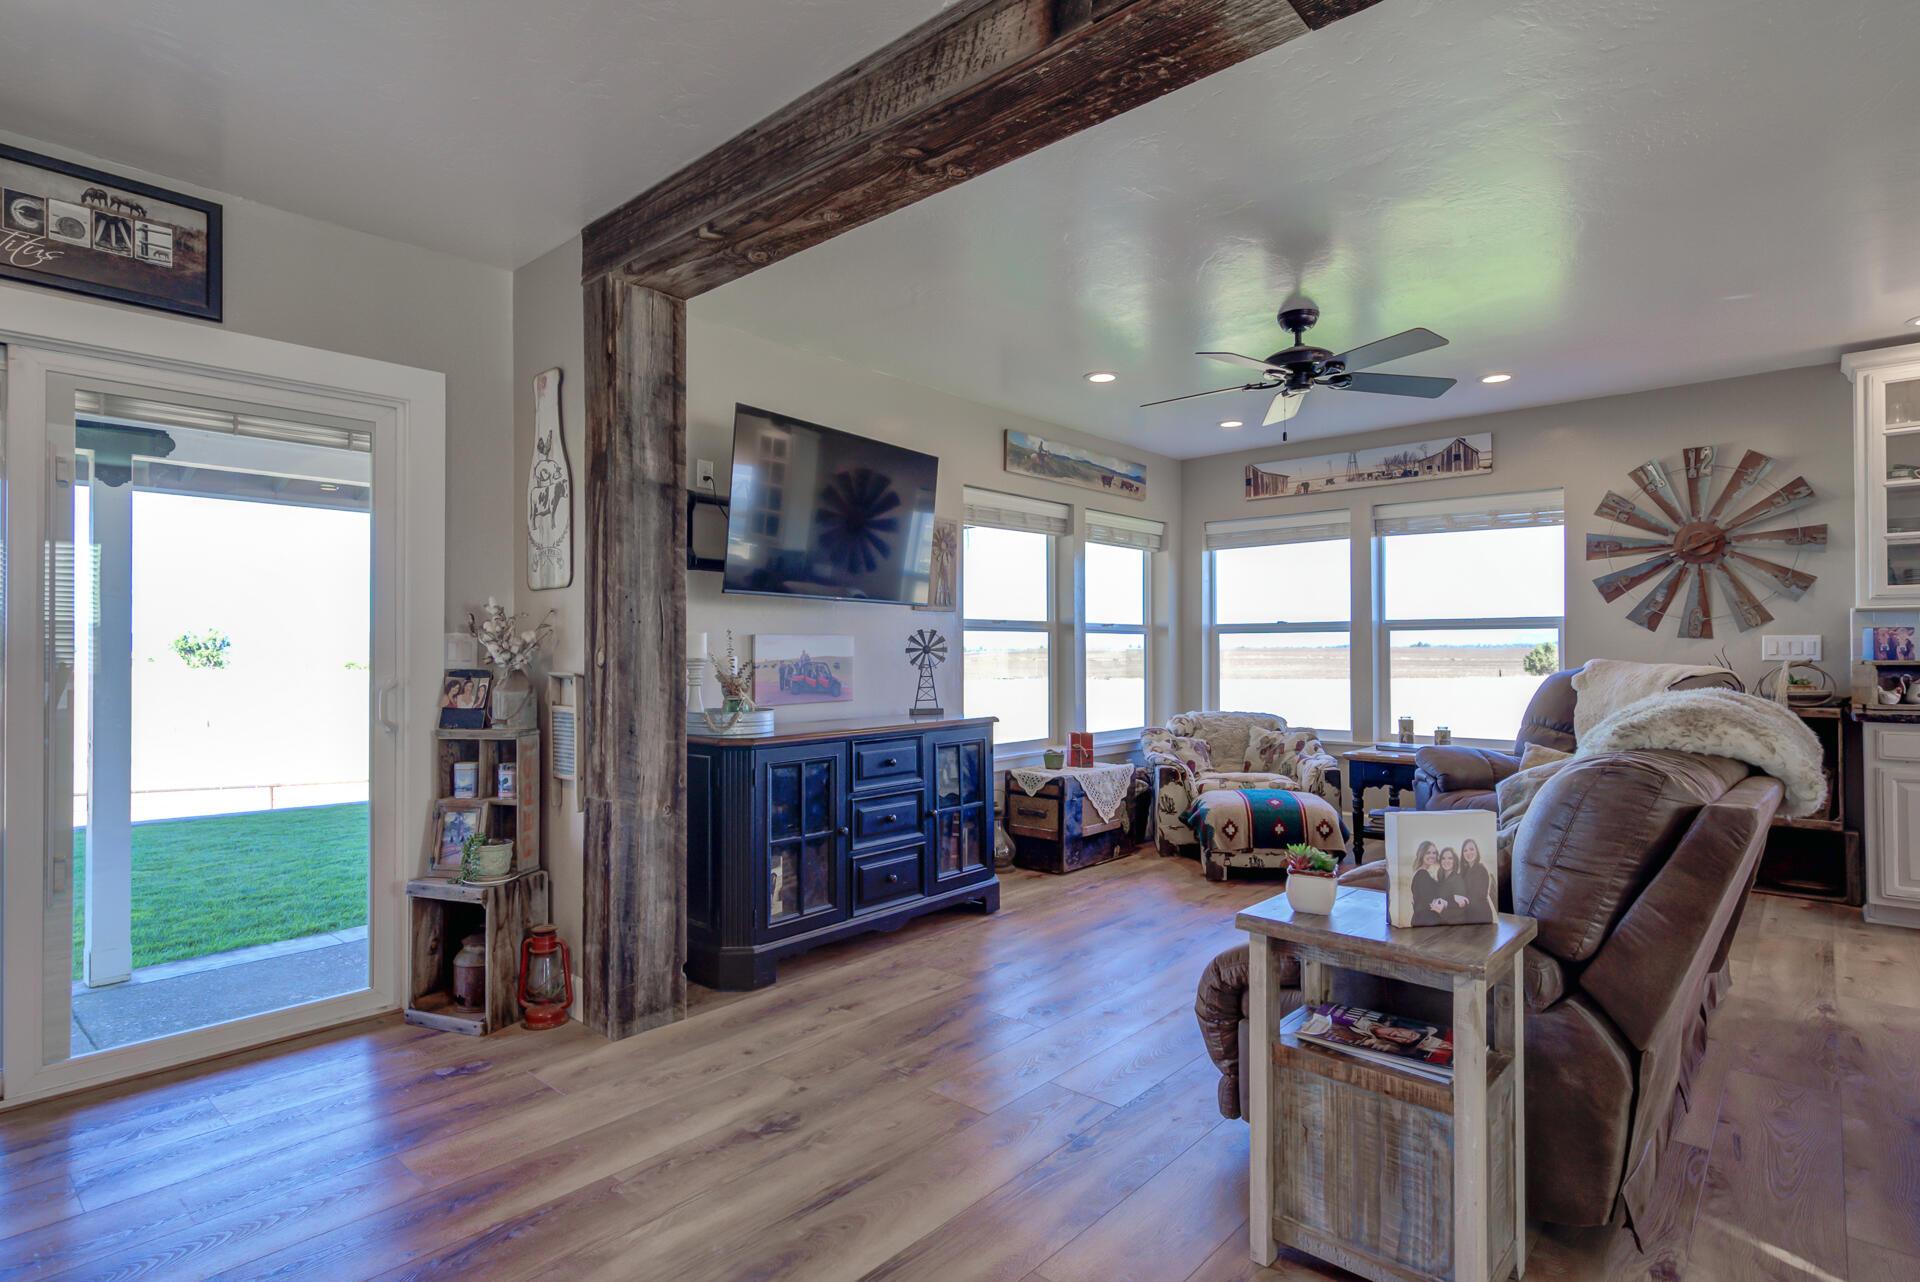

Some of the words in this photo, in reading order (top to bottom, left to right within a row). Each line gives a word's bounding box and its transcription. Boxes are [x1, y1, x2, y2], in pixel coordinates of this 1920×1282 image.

[1634, 462, 1665, 493] 11
[1686, 446, 1712, 478] 12
[1598, 493, 1635, 522] 10
[1688, 607, 1702, 638] 6
[1735, 600, 1761, 627] 5
[522, 743, 535, 858] PEPSI
